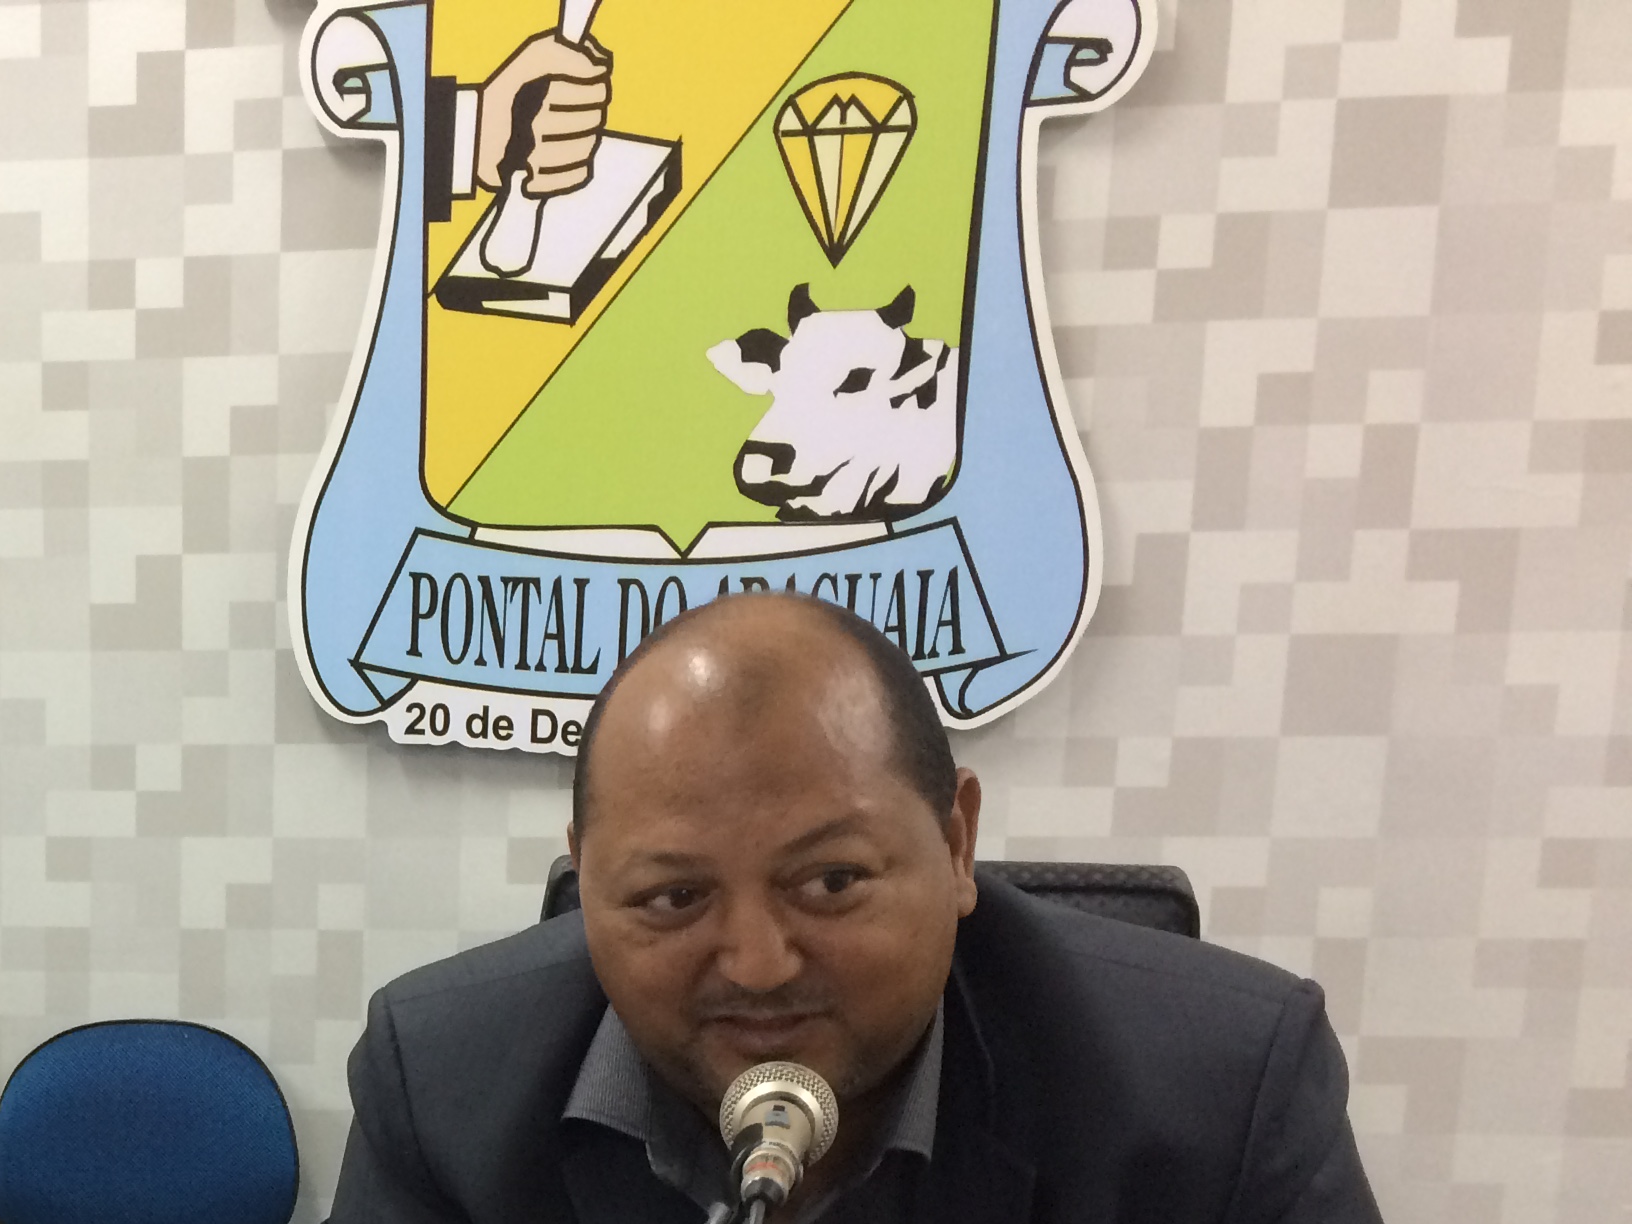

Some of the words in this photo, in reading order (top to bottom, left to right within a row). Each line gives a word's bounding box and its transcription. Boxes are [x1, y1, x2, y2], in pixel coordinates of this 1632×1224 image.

[406, 571, 601, 675] PONTAL
[404, 702, 451, 737] 20
[466, 705, 514, 740] de
